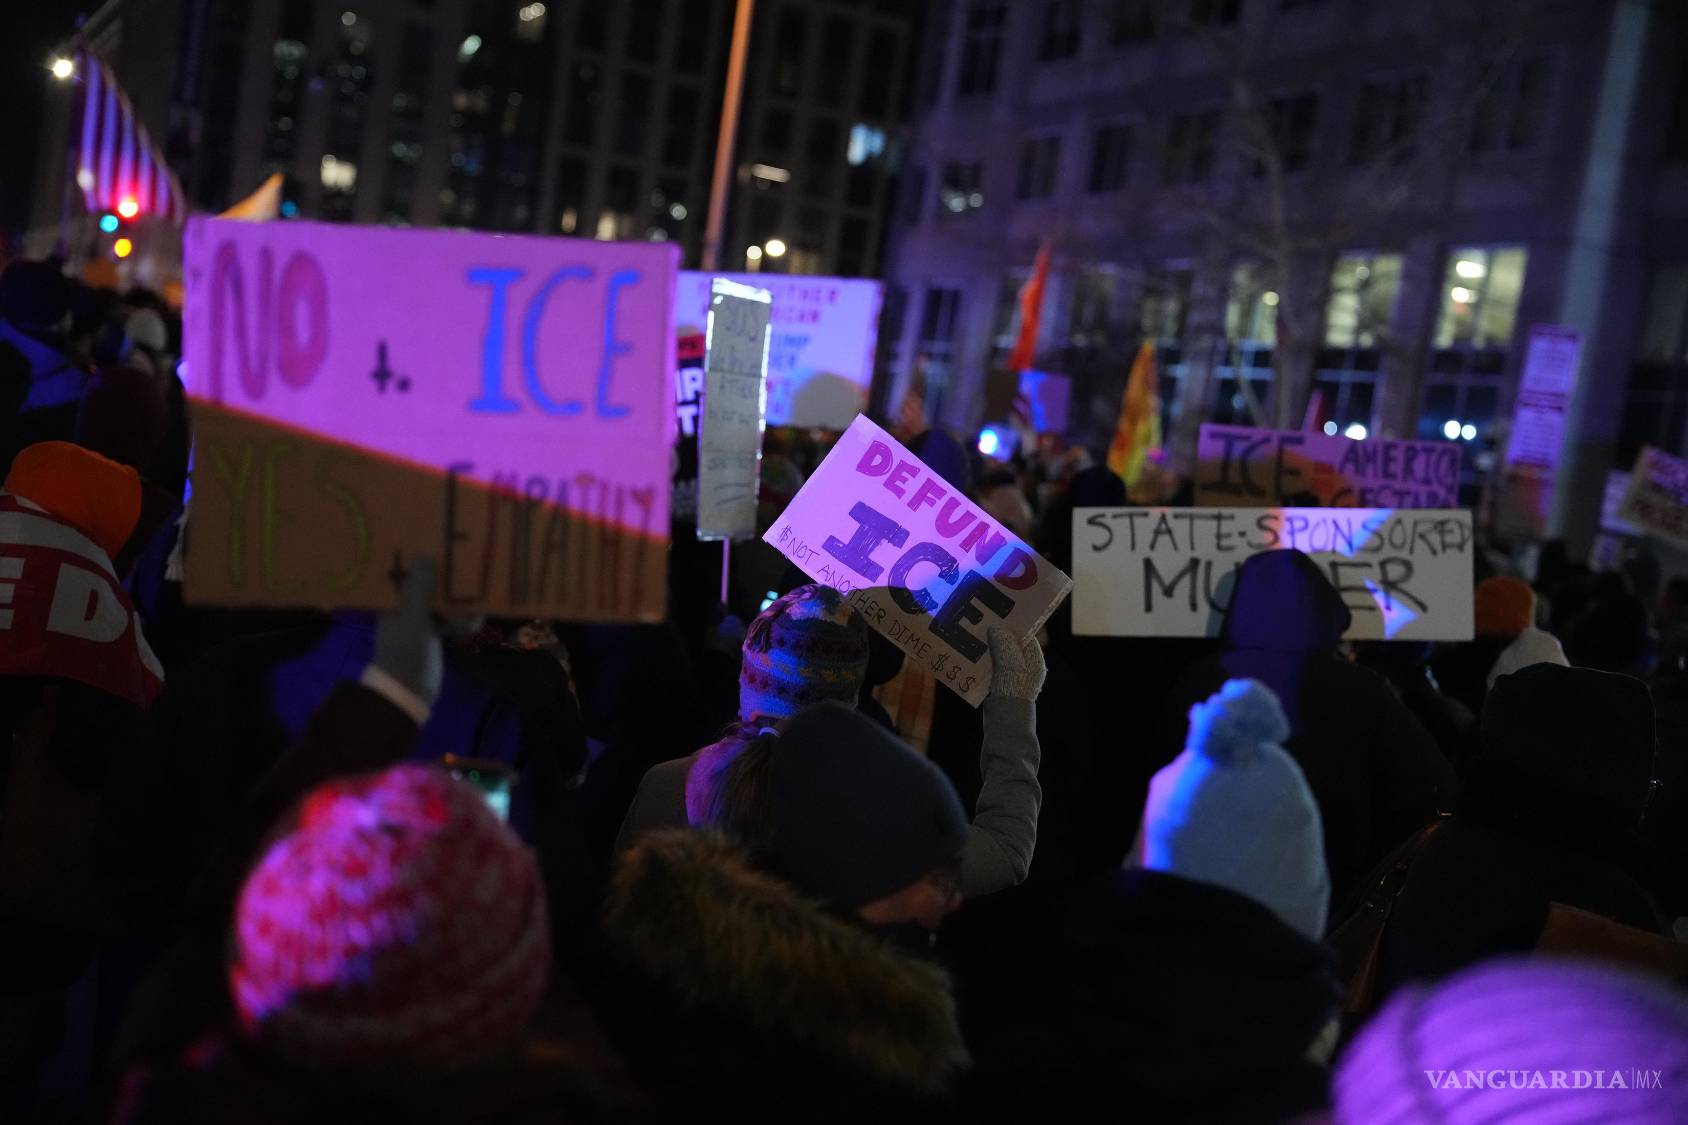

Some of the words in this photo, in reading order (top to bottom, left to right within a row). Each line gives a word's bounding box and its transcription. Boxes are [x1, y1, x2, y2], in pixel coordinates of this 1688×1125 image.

[208, 240, 329, 406] NO
[467, 265, 641, 418] ICE
[207, 443, 371, 592] YES
[444, 461, 656, 610] EMPATHY
[856, 440, 1038, 590] DEFUND
[1204, 431, 1304, 498] ICE
[816, 564, 886, 624] ANOTHER
[887, 620, 932, 660] DIME
[822, 501, 1016, 664] ICE
[1143, 556, 1428, 613] MUER
